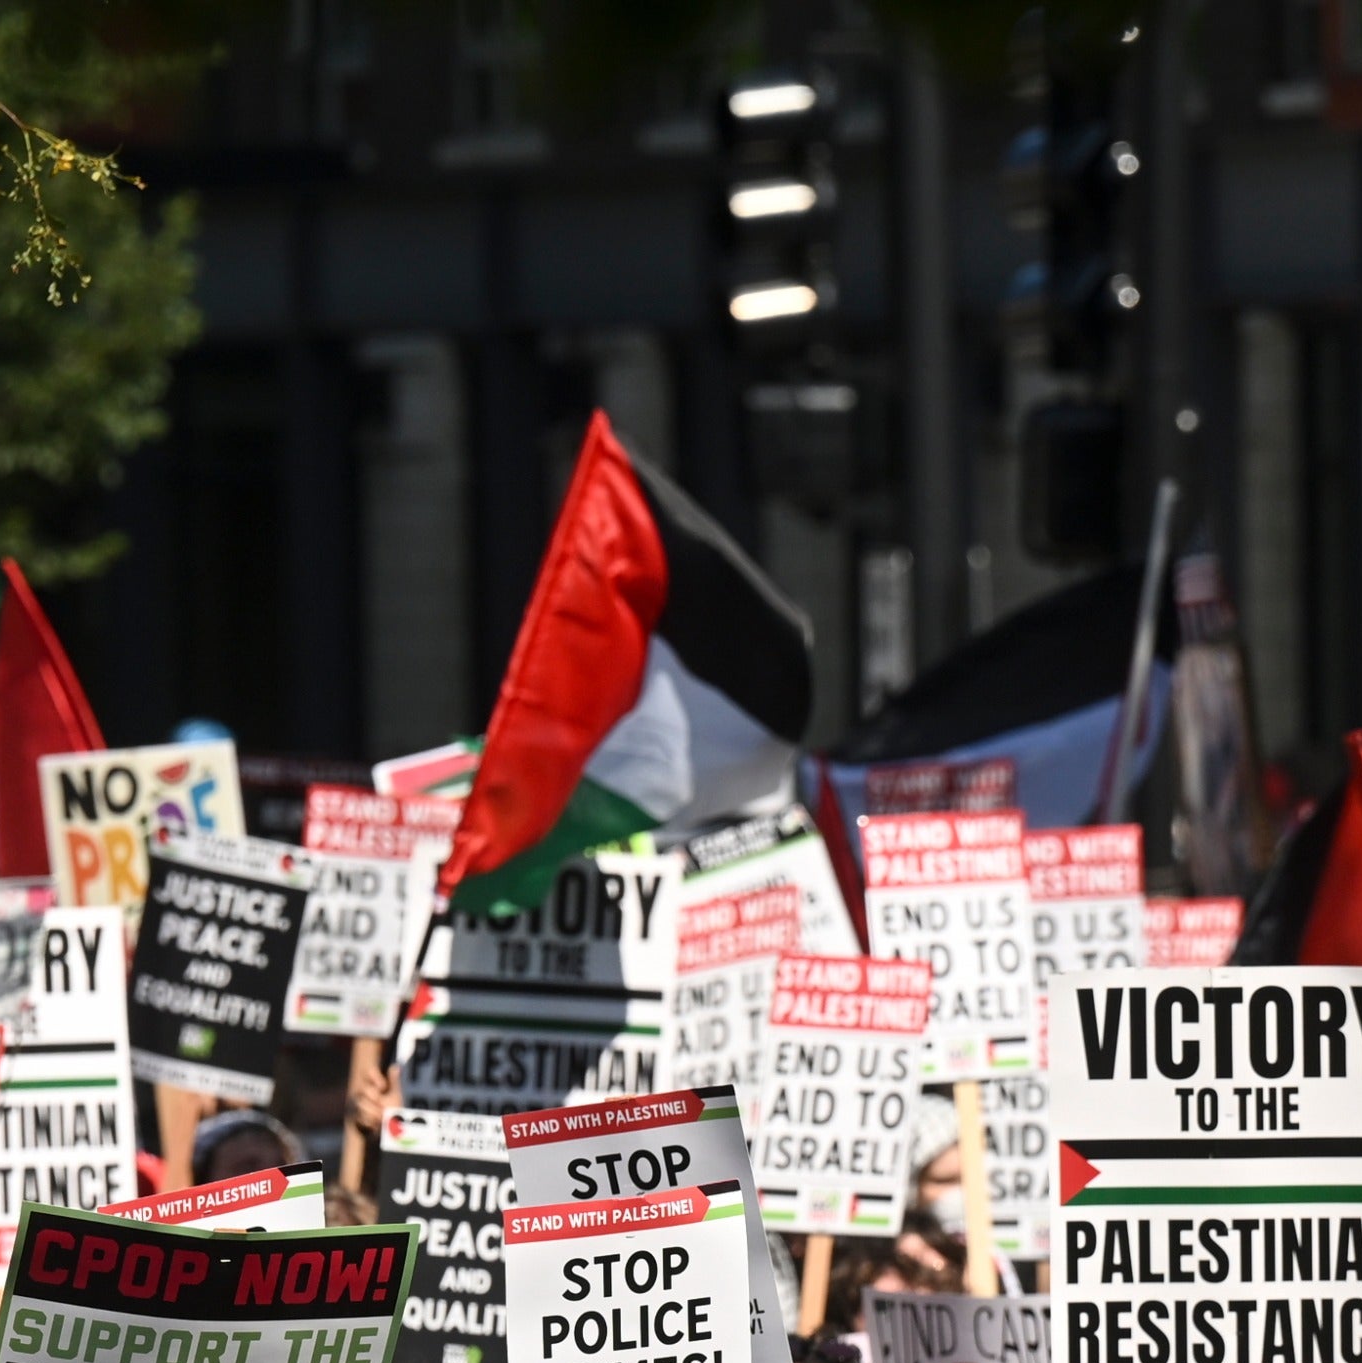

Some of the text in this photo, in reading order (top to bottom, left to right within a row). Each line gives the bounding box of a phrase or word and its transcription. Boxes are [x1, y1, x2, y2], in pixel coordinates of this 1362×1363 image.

[58, 766, 138, 821] NO
[865, 817, 1023, 854] STAND WITH
[881, 902, 950, 937] END
[776, 960, 933, 998] STAND WITH
[774, 1041, 844, 1078] END
[511, 1118, 561, 1140] STAND
[563, 1113, 603, 1135] WITH
[605, 1101, 689, 1130] PALESTINE!
[769, 1088, 906, 1130] AID TO
[1174, 1086, 1301, 1132] TO THE
[568, 1145, 692, 1199] STOP
[759, 1135, 903, 1178] ISRAEL!
[157, 1178, 273, 1220] WITH PALESTINE!
[511, 1199, 694, 1234] STAND WITH PALESTINE!
[27, 1229, 396, 1306] CPOP NOW!
[439, 1266, 492, 1294] AND
[562, 1246, 690, 1302] STOP
[542, 1297, 713, 1360] POLICE
